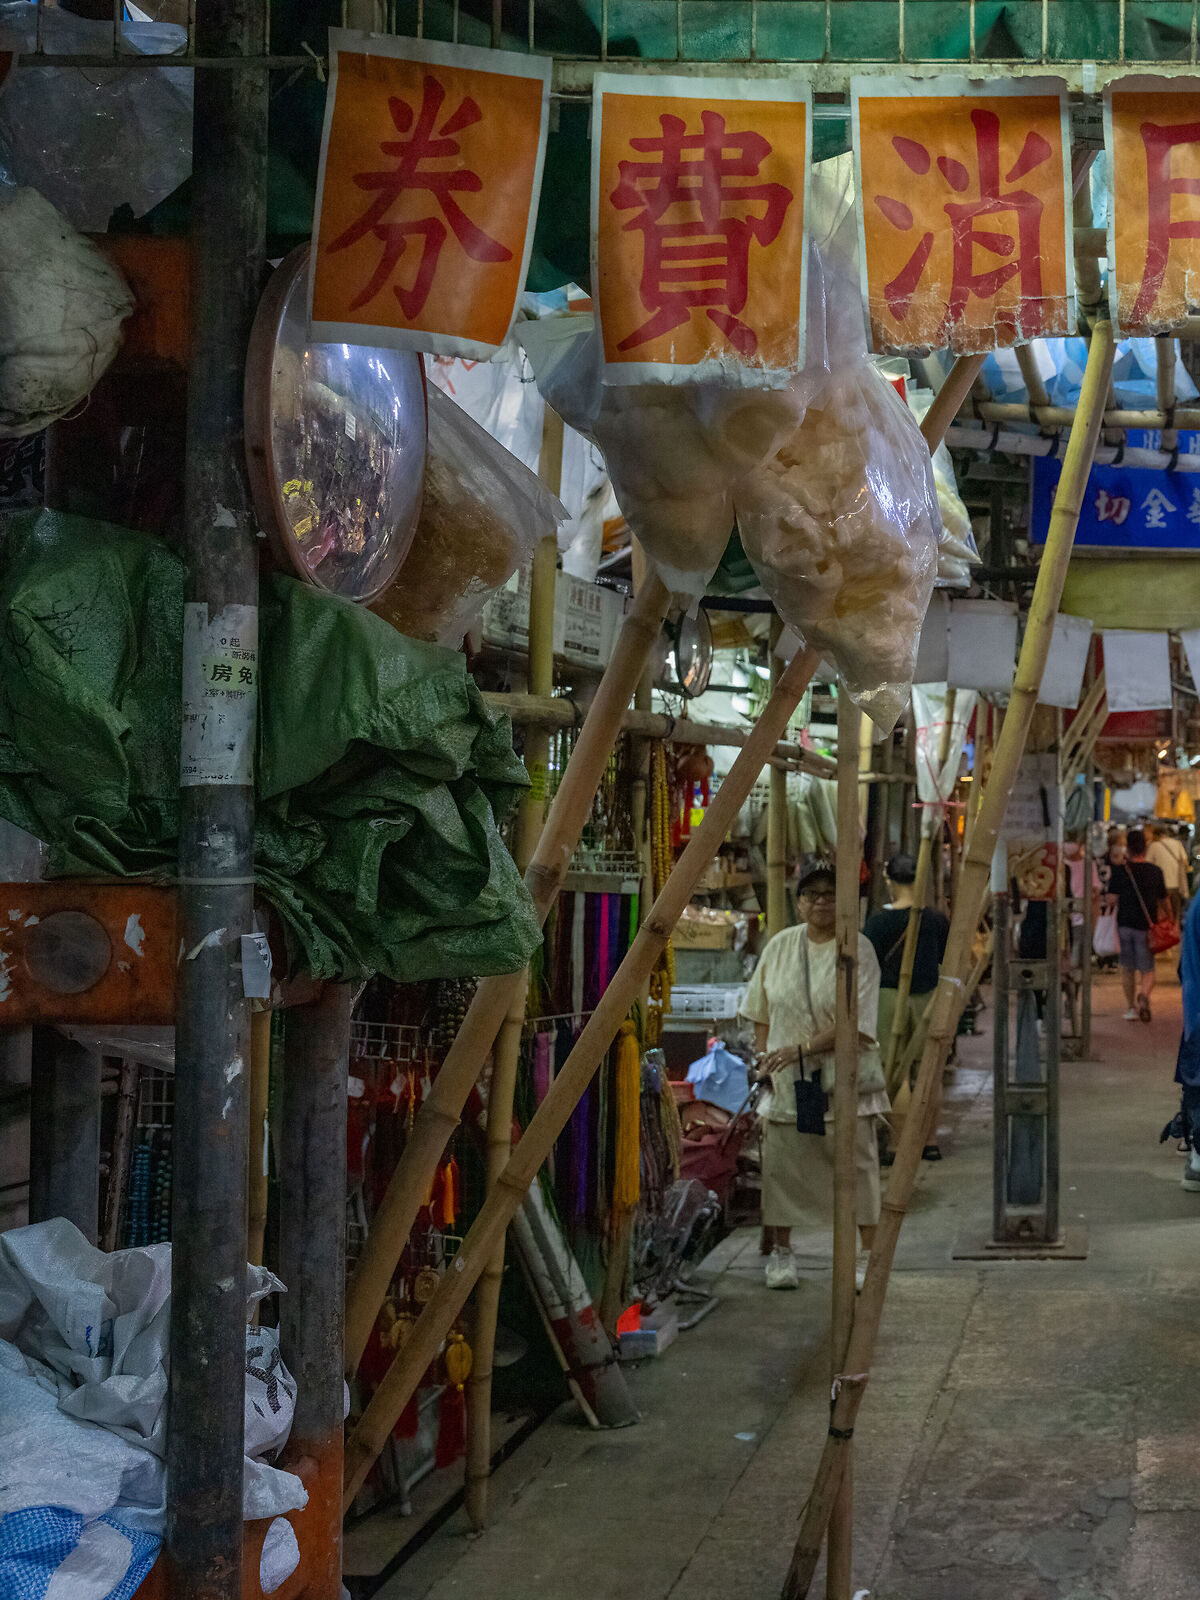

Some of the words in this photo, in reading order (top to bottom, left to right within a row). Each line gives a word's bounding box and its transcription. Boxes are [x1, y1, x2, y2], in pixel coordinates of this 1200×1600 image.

[327, 75, 513, 321] 券
[609, 111, 794, 356] 費
[875, 108, 1053, 345] 消
[203, 663, 253, 685] 房免
